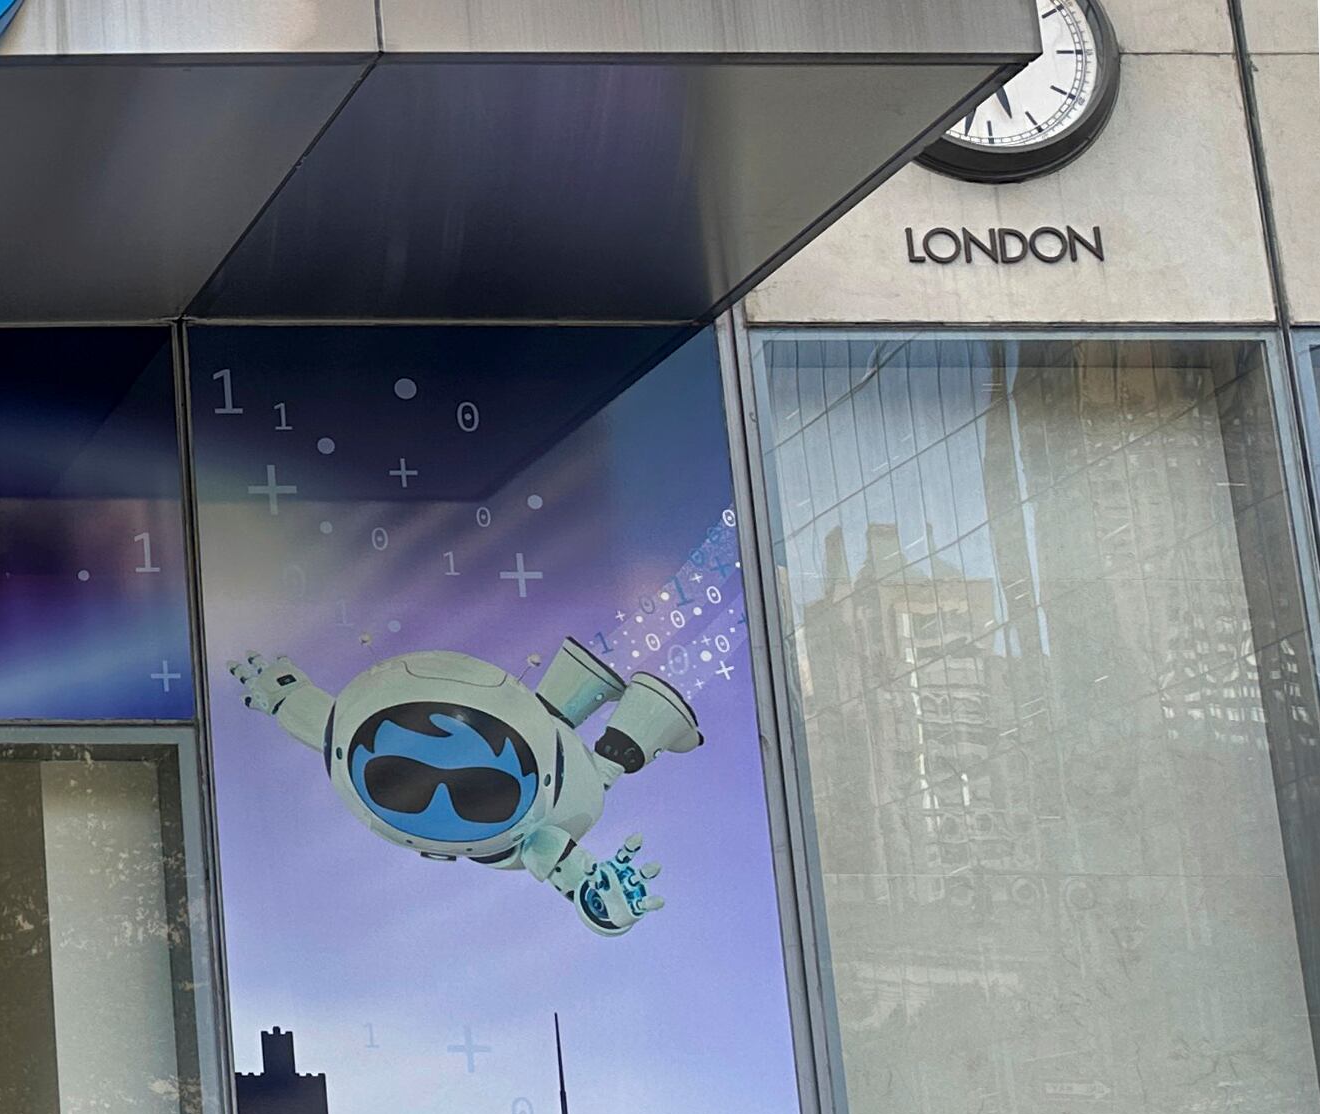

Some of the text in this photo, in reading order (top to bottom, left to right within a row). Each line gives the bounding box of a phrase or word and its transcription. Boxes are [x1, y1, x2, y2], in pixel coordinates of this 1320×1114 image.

[905, 225, 1105, 265] LONDON
[212, 368, 243, 414] 1
[273, 402, 292, 430] 1
[456, 401, 479, 432] 0
[475, 506, 491, 527] 0
[134, 532, 160, 572] 1
[371, 526, 388, 550] 0
[443, 551, 460, 576] 1
